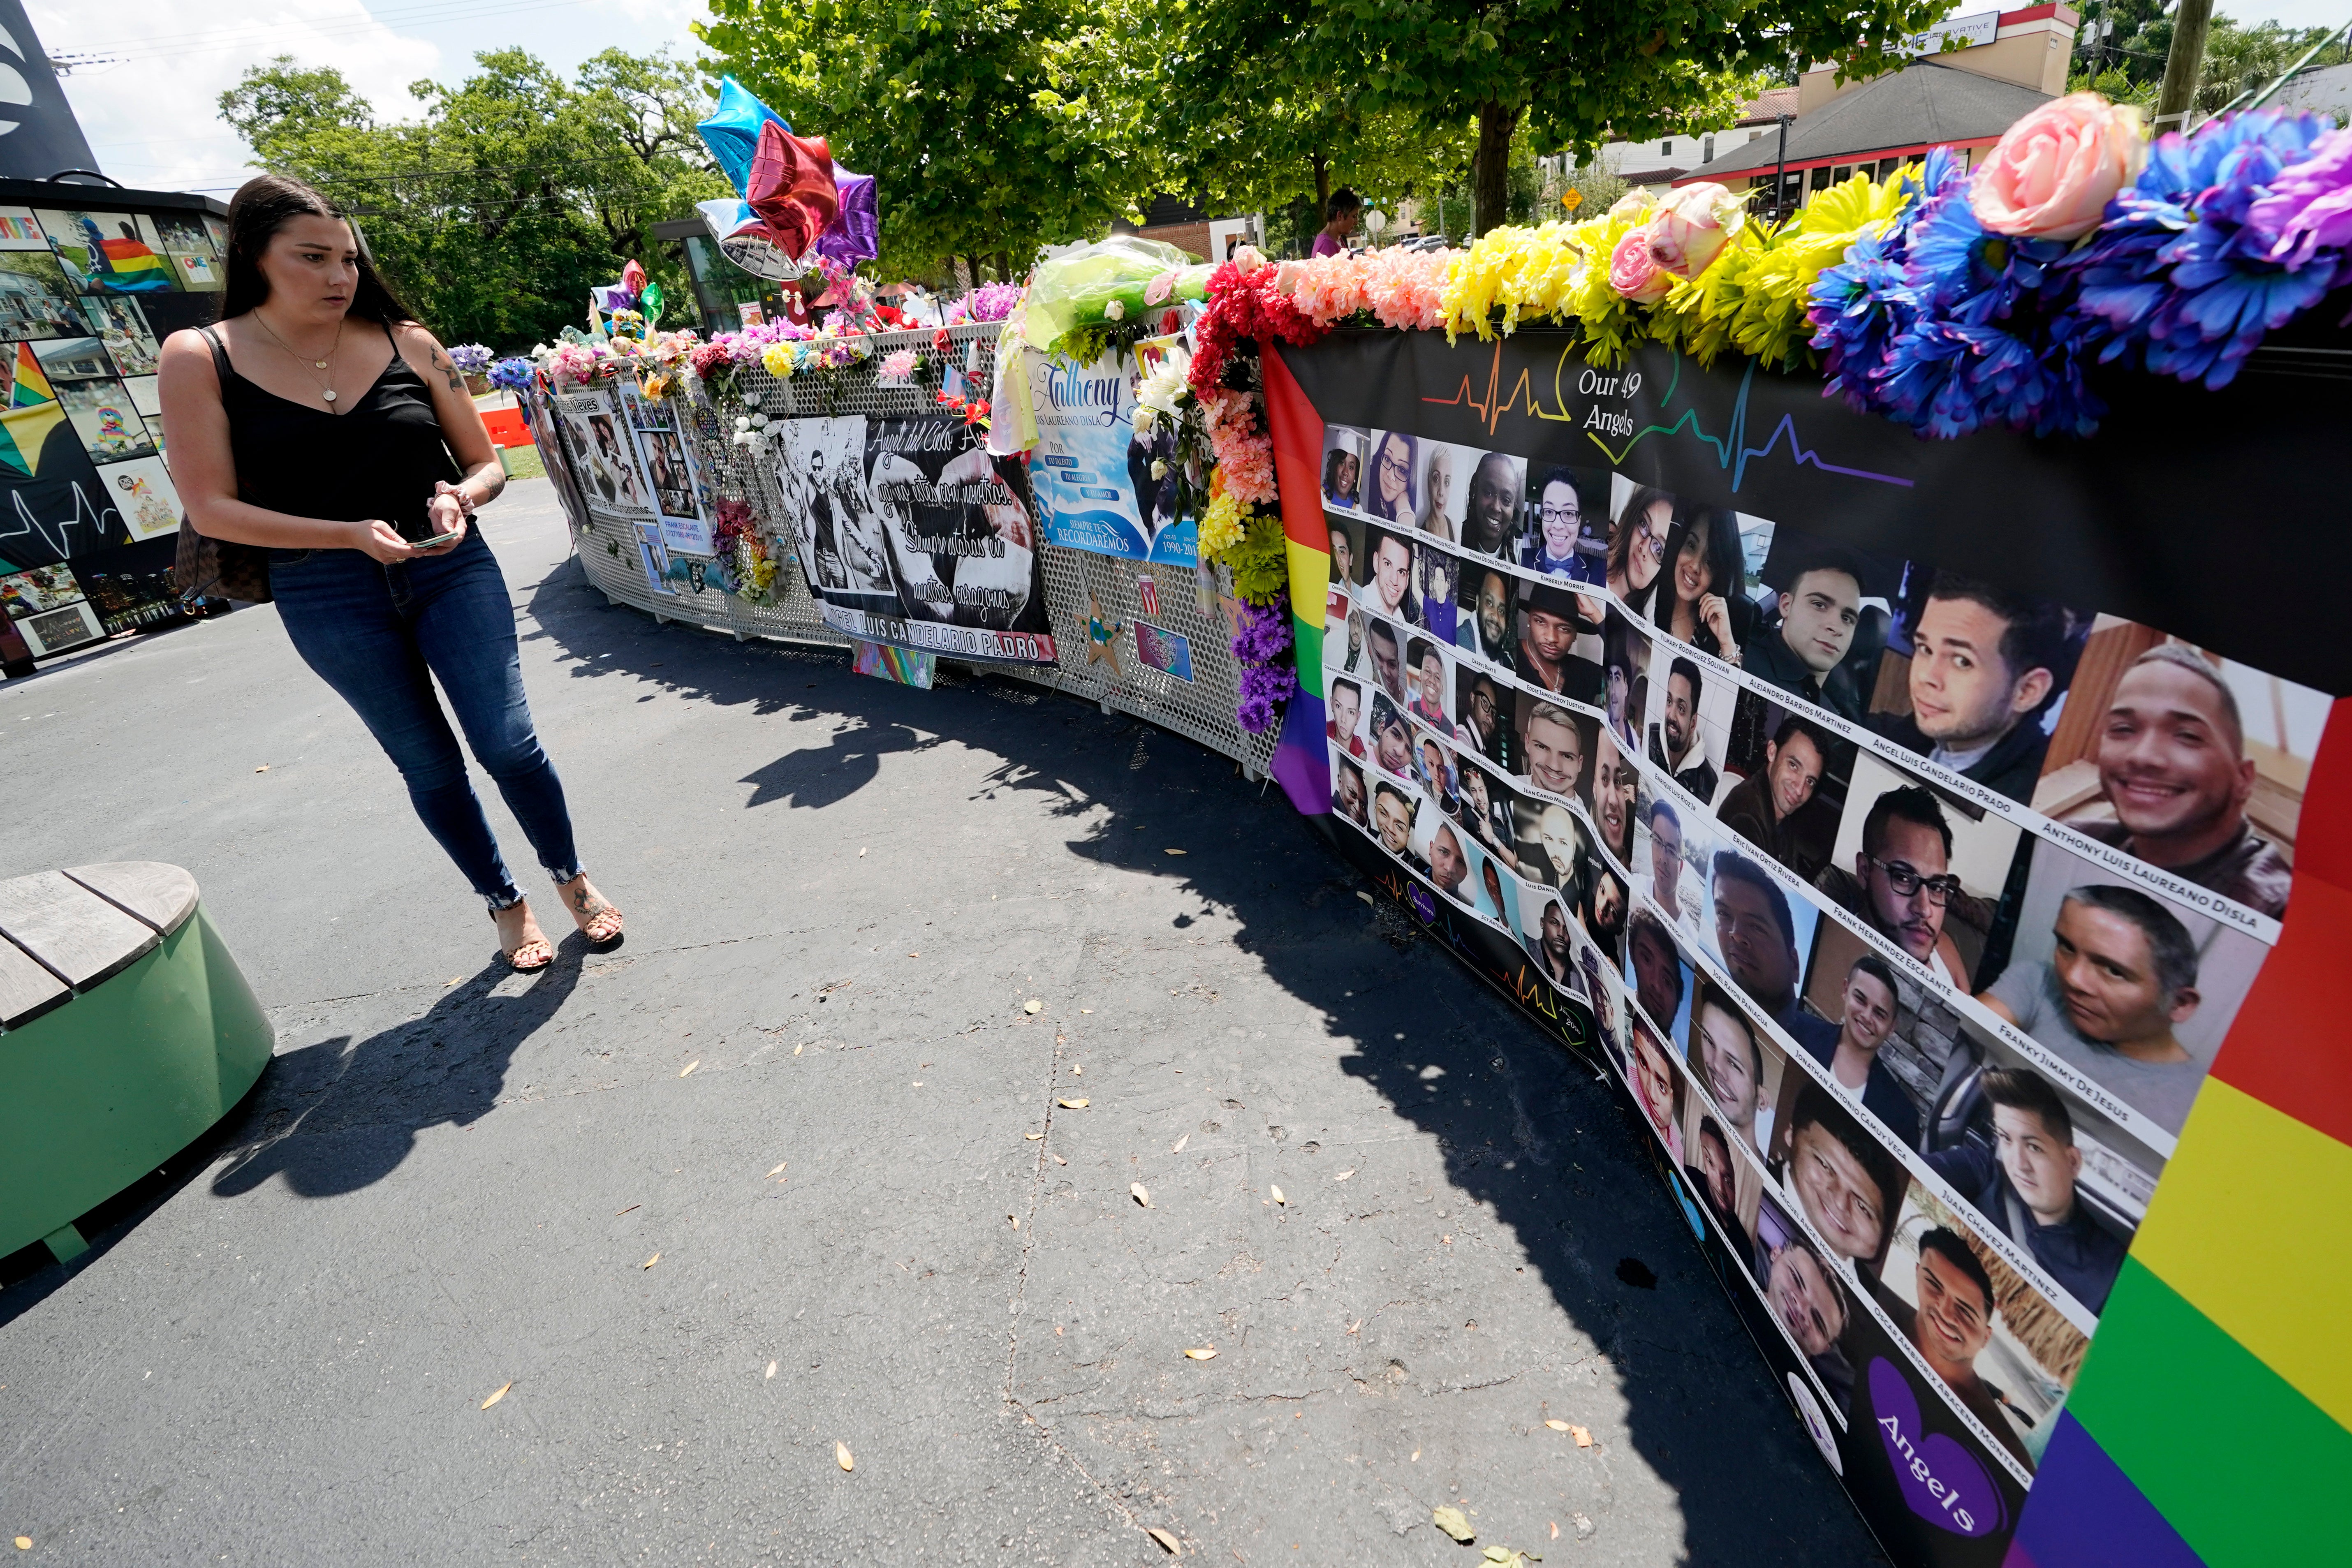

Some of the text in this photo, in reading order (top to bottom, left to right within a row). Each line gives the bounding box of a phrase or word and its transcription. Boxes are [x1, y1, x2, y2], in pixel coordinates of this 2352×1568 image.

[184, 257, 207, 269] ONE
[1034, 361, 1129, 427] Anthony
[1579, 369, 1641, 399] Our 49
[569, 398, 599, 412] Nieves
[1035, 415, 1101, 426] UIS LAUREANO DISLA
[1583, 405, 1633, 437] Angels
[868, 420, 905, 469] Angel
[905, 421, 926, 451] del
[1049, 441, 1065, 454] POR
[1054, 457, 1072, 466] TALENTO
[894, 484, 910, 502] no
[940, 484, 959, 502] con
[1097, 490, 1112, 499] AMOR
[678, 523, 699, 532] ESCALANTE
[1070, 519, 1102, 533] SIEMPRE TE
[1370, 516, 1380, 525] AMANDA
[1057, 527, 1130, 552] RECORDAREMOS
[1495, 560, 1512, 571] DRAYTON
[1540, 575, 1584, 591] KIMBERLY MORRIS
[826, 604, 1039, 660] ANGEL LUIS CANDELARIO PADRÓ
[1634, 616, 1645, 629] FLORES
[1472, 658, 1484, 668] DARRYL
[1484, 664, 1493, 672] BURT
[1660, 633, 1729, 674] YILMARY RODRIGUEZ SOLIVAN
[1338, 669, 1352, 678] ANTONIO
[1527, 685, 1586, 711] EDDIE JAMOLDROY JUSTICE
[1749, 679, 1851, 734] ALEJANDRO BARRIOS MARTINEZ
[1470, 753, 1481, 763] JAVIER
[1382, 774, 1393, 782] RAMON
[1393, 779, 1411, 791] GUERRERO
[1873, 739, 2011, 812] ANGEL LUIS CANDELARIO PRADO
[1523, 787, 1585, 818] JEAN CARLO MENDEZ PEREZ
[1655, 773, 1696, 812] ENRIQUE LUIS JR
[1733, 835, 1799, 888] ERIC IVAN ORTIZ RIVERA
[2042, 823, 2257, 928] ANTHONY LUIS LAUREANO DISLA
[1537, 885, 1556, 894] DANIEL
[1413, 896, 1434, 916] Survivors
[1489, 919, 1505, 932] ANTONIO
[1653, 905, 1668, 926] ARTHUR
[1668, 920, 1683, 941] WRIGHT
[1833, 907, 1952, 996] FRANK HERNANDEZ ESCALANTE
[1558, 985, 1585, 1002] TOMLINSON
[1713, 969, 1768, 1027] JOEL RAYON PANIAGUA
[1566, 1018, 1581, 1034] 2016
[1658, 1033, 1671, 1051] VIELMA
[1999, 1025, 2075, 1082] FRANKY JIMMY
[1795, 1050, 1907, 1161] JONATHAN ANTONIO CAMUY VEGA
[1698, 1086, 1749, 1156] MARTIN BENITEZ TORRES
[1779, 1191, 1853, 1284] MIGUEL ANGEL HONORATO
[1942, 1190, 2058, 1300] JUAN CHAVEZ MARTINEZ
[1874, 1307, 2029, 1484] OSCAR AMBIORIX ARACENA MONTERO
[1877, 1414, 1975, 1532] Angels
